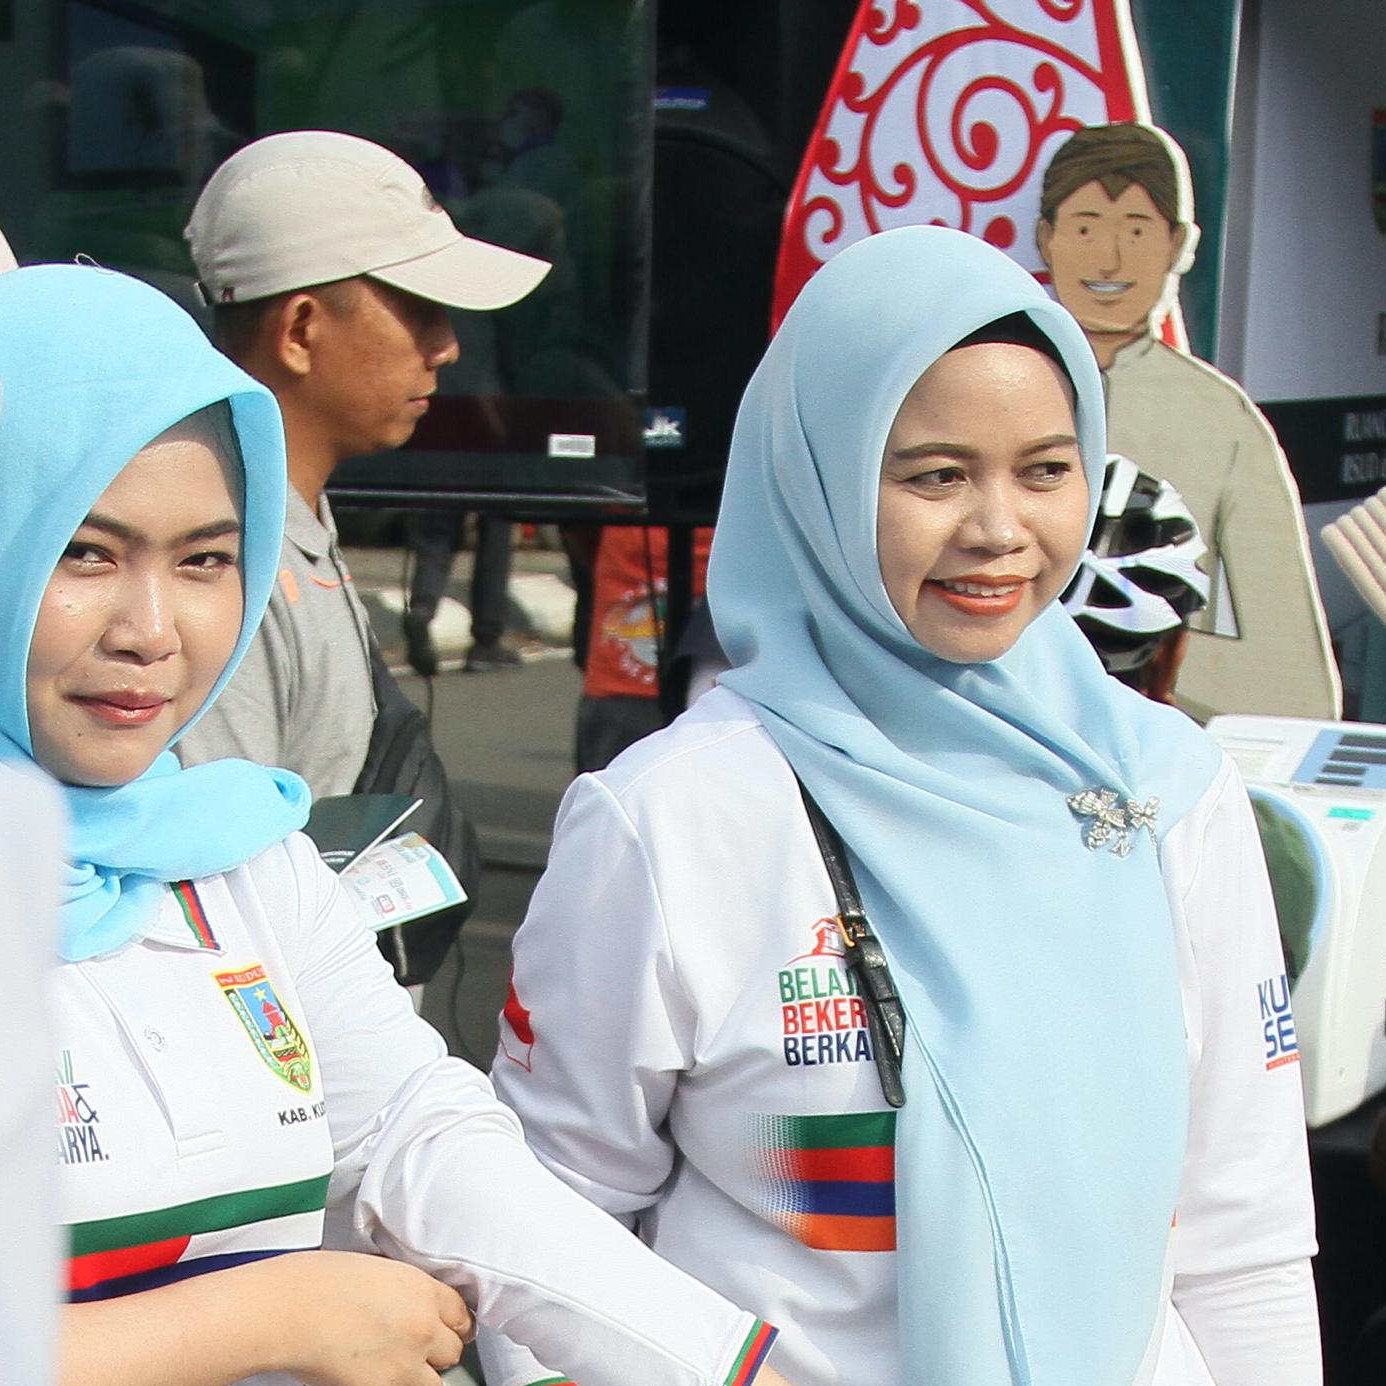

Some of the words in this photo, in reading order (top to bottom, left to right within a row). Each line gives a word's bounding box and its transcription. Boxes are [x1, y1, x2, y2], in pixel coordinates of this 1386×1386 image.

[778, 966, 859, 1003] BELAJ
[1256, 973, 1289, 1021] KU
[782, 996, 869, 1036] BEKER
[1263, 1012, 1298, 1060] SE
[783, 1029, 876, 1067] BERKA
[277, 1106, 312, 1127] KAB.
[58, 1124, 110, 1165] ARYA.
